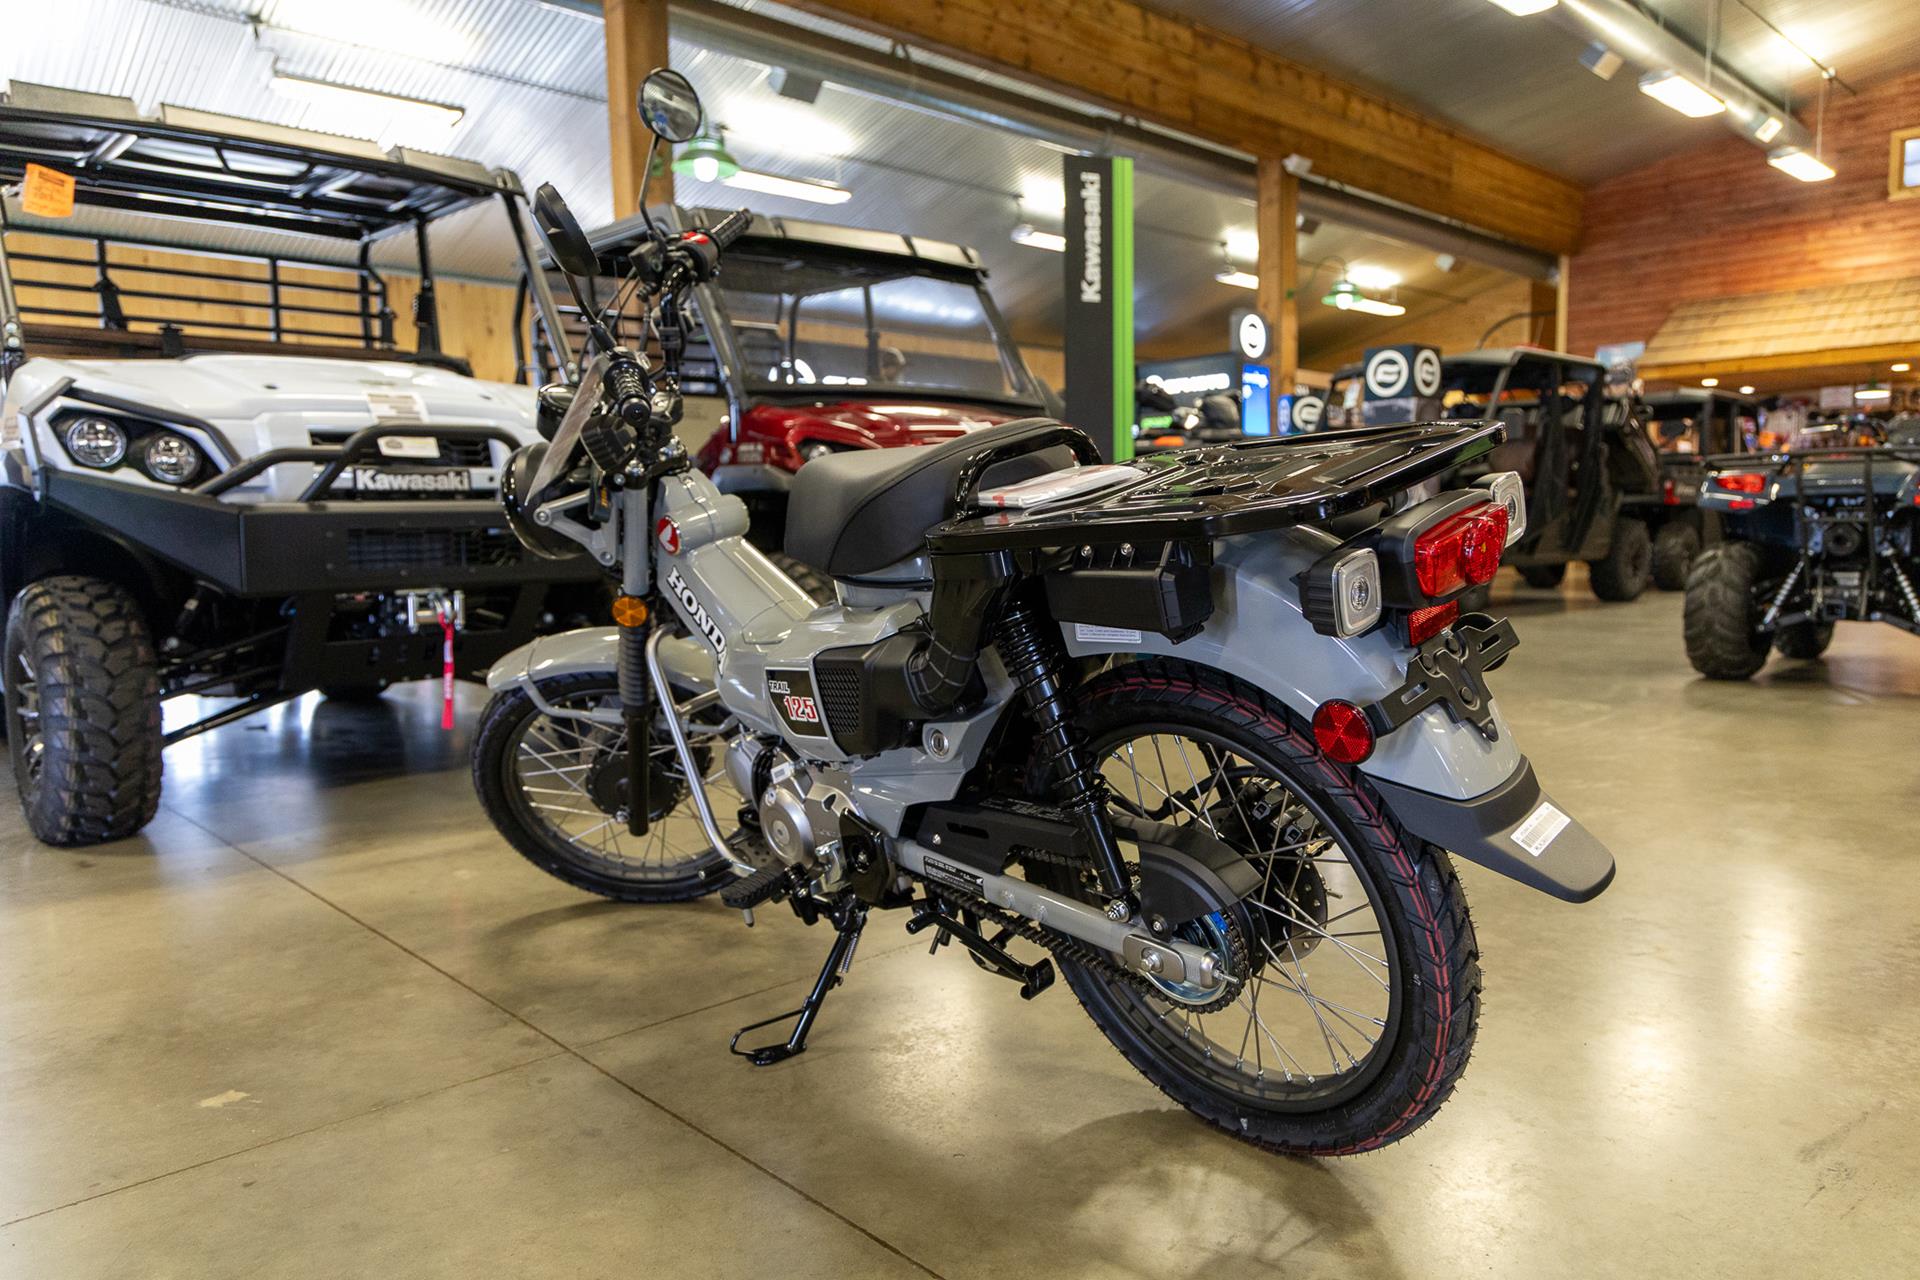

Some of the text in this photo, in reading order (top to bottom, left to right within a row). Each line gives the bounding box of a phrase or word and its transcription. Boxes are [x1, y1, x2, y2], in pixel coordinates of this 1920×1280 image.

[1080, 171, 1102, 303] Kawasaki
[355, 468, 470, 491] Kawasaki
[667, 565, 728, 679] HONDA
[768, 680, 790, 694] TRAIL
[784, 695, 819, 723] 125
